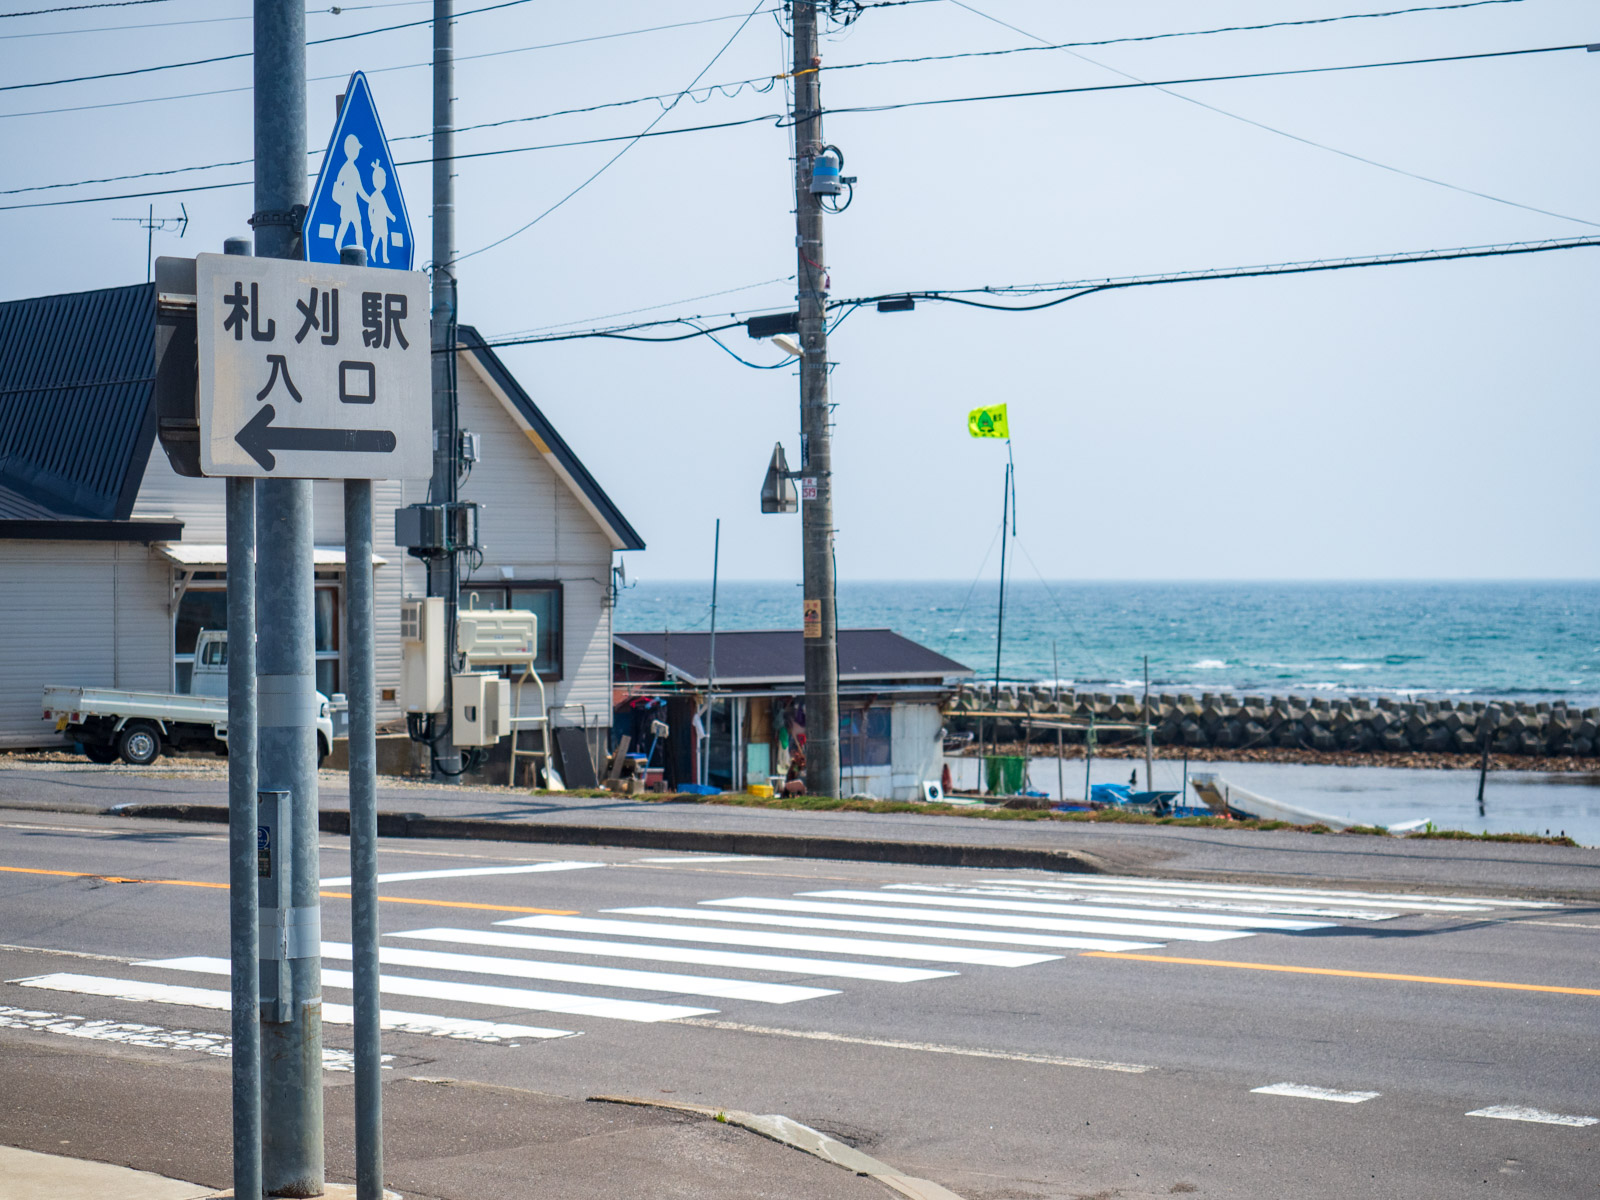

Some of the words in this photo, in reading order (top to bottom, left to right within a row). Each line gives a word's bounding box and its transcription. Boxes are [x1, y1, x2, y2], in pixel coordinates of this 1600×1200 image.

[223, 281, 410, 351] 札刈駅
[256, 354, 376, 404] 入口
